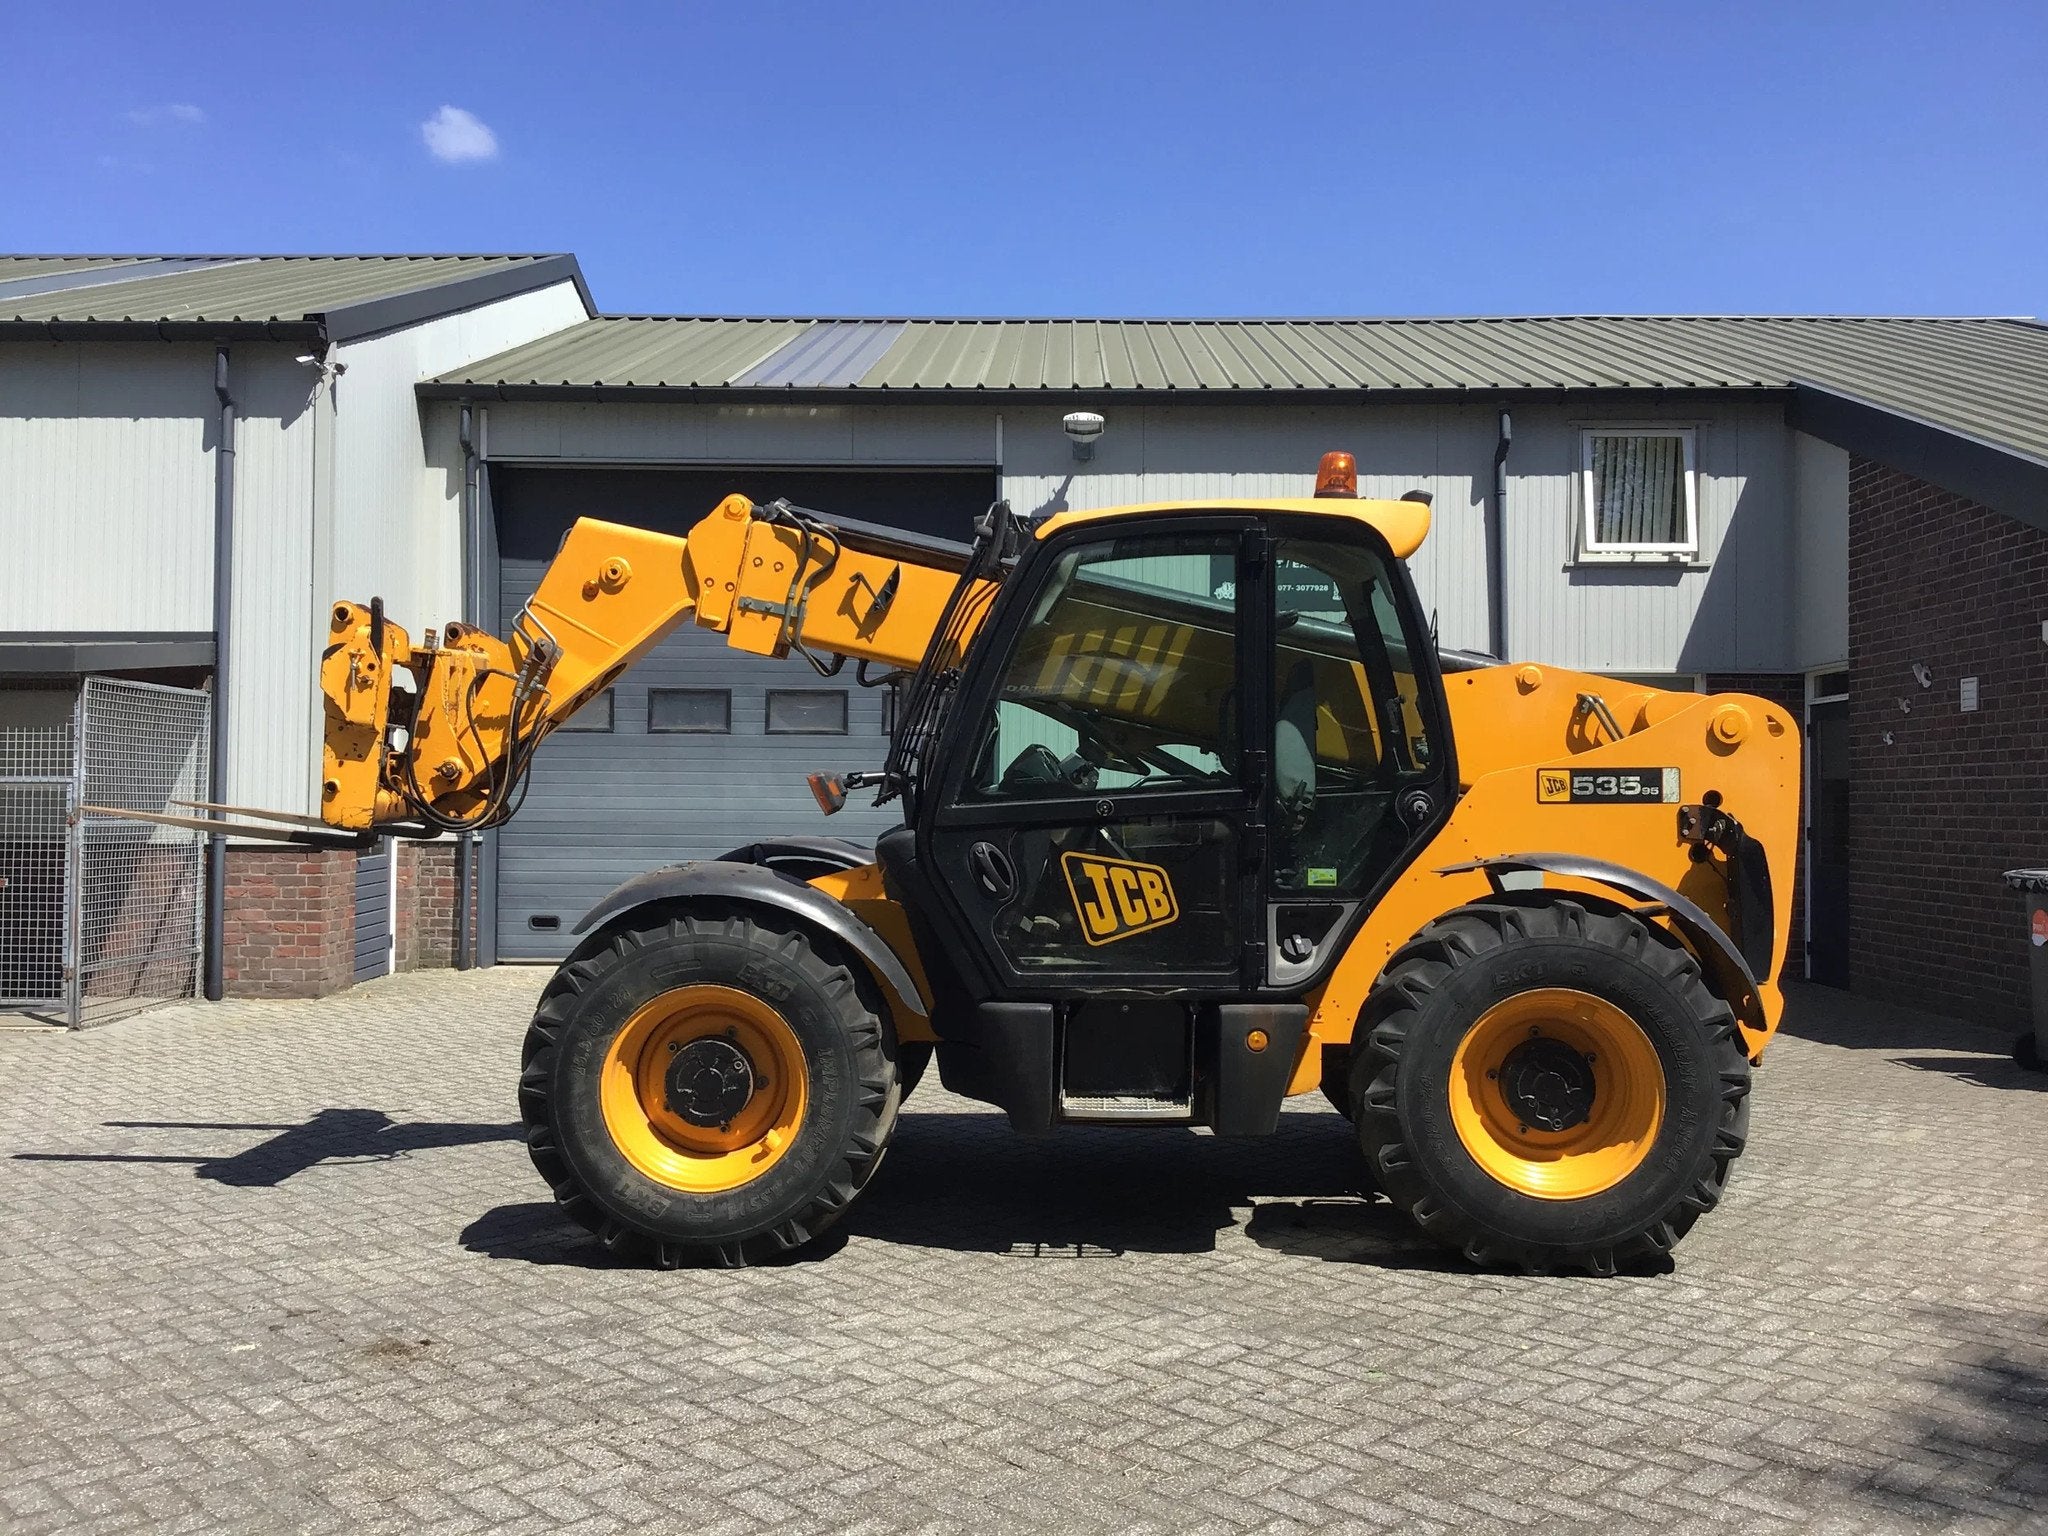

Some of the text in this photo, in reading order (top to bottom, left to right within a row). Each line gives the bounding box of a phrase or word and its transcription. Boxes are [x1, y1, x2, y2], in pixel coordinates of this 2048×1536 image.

[1546, 777, 1567, 794] JCB
[1572, 776, 1660, 796] 535 95
[1081, 862, 1171, 935] JCB
